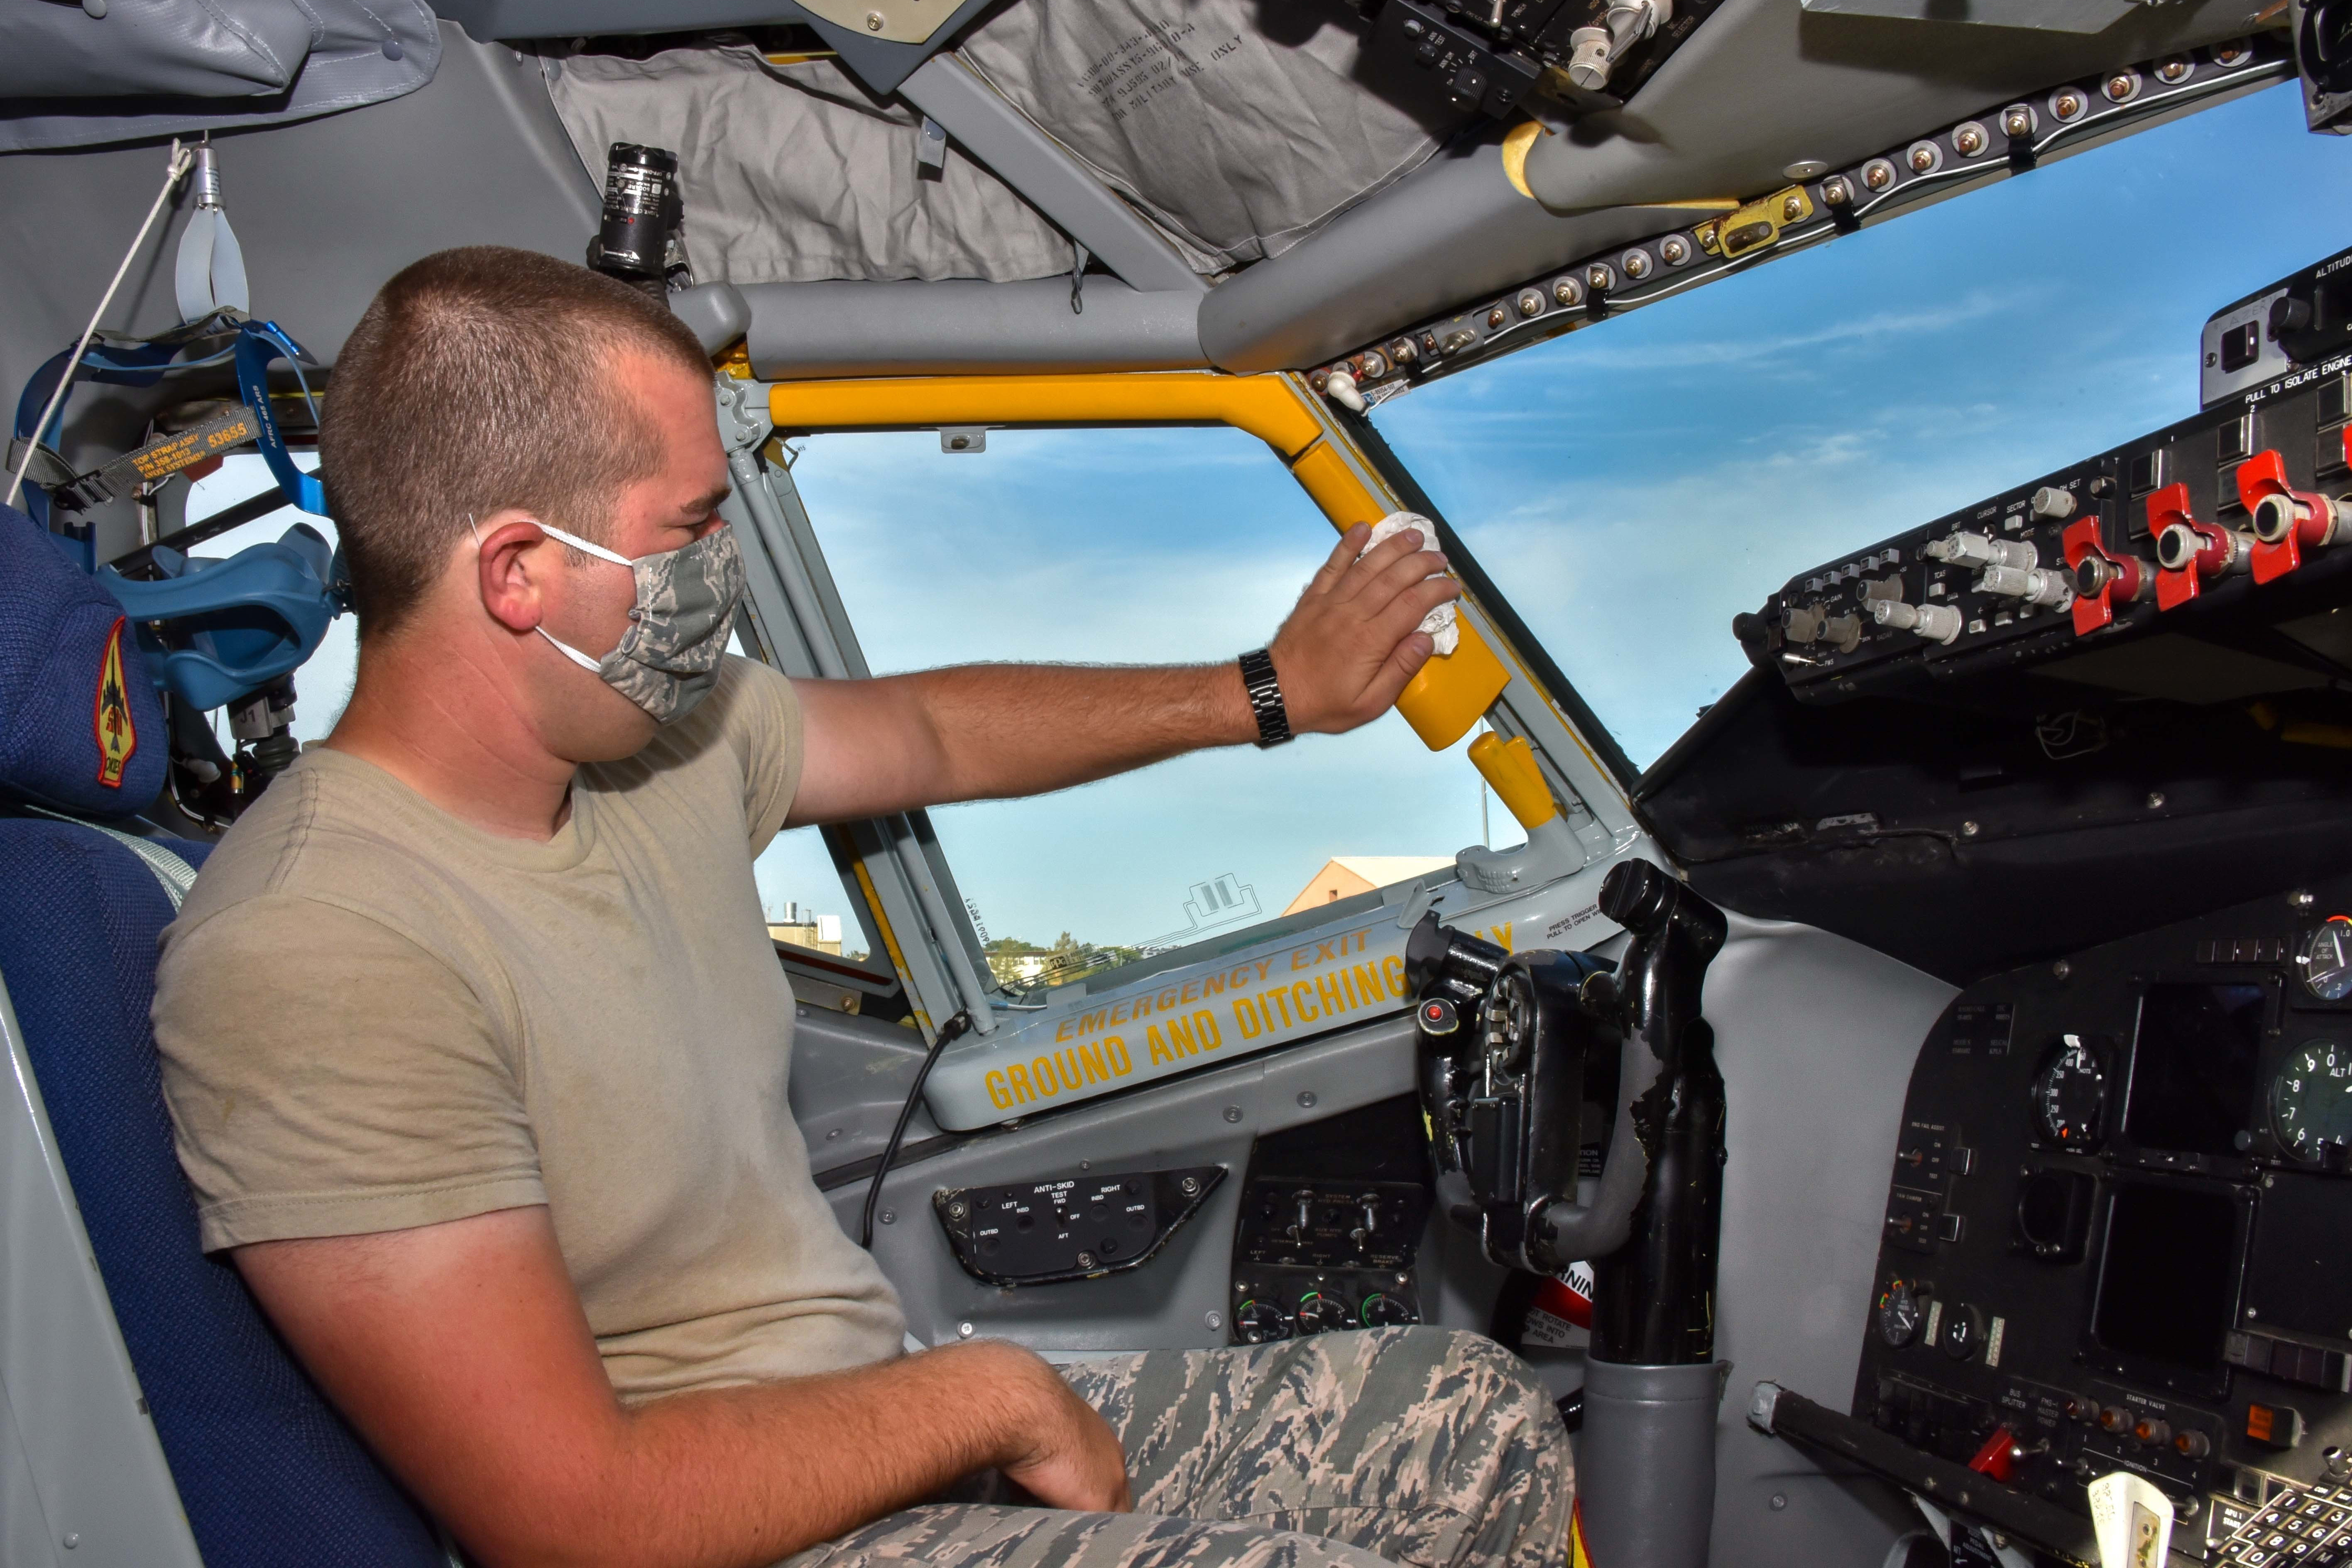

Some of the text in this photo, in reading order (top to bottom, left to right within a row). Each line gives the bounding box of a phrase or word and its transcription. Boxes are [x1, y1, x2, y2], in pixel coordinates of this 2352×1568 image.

[1672, 15, 1695, 38] SELECTOR
[1434, 34, 1445, 46] TEST
[1211, 34, 1242, 61] ONLY
[2245, 390, 2266, 404] PULL
[2270, 384, 2280, 394] TO
[2285, 368, 2318, 389] ISOLATE
[2250, 405, 2255, 413] 2
[252, 385, 277, 448] AFRC 465 ARS
[208, 422, 247, 449] 53655
[133, 434, 199, 465] TOP STRAP ASSY
[2069, 479, 2081, 489] SET
[2007, 500, 2026, 513] SECTOR
[1977, 506, 1997, 520] CURSOR
[1951, 521, 1961, 531] BRT
[2020, 528, 2035, 539] MODE
[1934, 570, 1946, 580] TCAS
[1831, 593, 1843, 603] GAIN
[1876, 631, 1892, 642] RADAR
[240, 709, 256, 723] J1
[1549, 904, 1597, 932] PRESS TRIGGER
[1547, 930, 1563, 939] PULL
[1574, 914, 1591, 926] OPEN
[1050, 956, 1067, 969] PPG
[1055, 928, 1373, 1043] EMERGENCY EXIT
[984, 954, 1407, 1110] GROUND AND DITCHING
[2066, 1059, 2074, 1067] 400
[2308, 1059, 2315, 1072] 9
[2327, 1054, 2335, 1067] 0
[2330, 1068, 2346, 1077] ALT
[2293, 1079, 2300, 1092] 8
[2050, 1089, 2058, 1097] 300
[2051, 1105, 2059, 1113] 250
[2290, 1107, 2296, 1120] 7
[2298, 1128, 2305, 1140] 6
[1034, 1181, 1074, 1194] ANTI-SKID
[1101, 1184, 1121, 1193] RIGHT
[1002, 1201, 1018, 1209] LEFT
[1542, 1314, 1571, 1331] ROTATE
[1532, 1330, 1554, 1343] AREA
[1547, 1325, 1565, 1338] INTO
[2009, 1388, 2021, 1398] BUS
[2002, 1396, 2026, 1409] SPLITTER
[2126, 1394, 2166, 1410] STARTER VALVE
[2038, 1406, 2059, 1418] MASTER
[2037, 1416, 2056, 1428] POWER
[2124, 1460, 2147, 1472] IGNITION
[2285, 1497, 2296, 1507] 1
[2225, 1508, 2238, 1517] APU
[2305, 1504, 2320, 1514] 2
[2266, 1513, 2279, 1523] 4
[2330, 1511, 2345, 1522] 3
[2223, 1517, 2242, 1529] START
[2288, 1520, 2302, 1530] 5
[2247, 1528, 2261, 1538] 7
[2312, 1528, 2326, 1538] 6
[2269, 1536, 2283, 1546] 8
[2337, 1536, 2352, 1546] G
[2293, 1544, 2307, 1554] 9
[2250, 1552, 2264, 1562] 0
[2316, 1552, 2334, 1563] M
